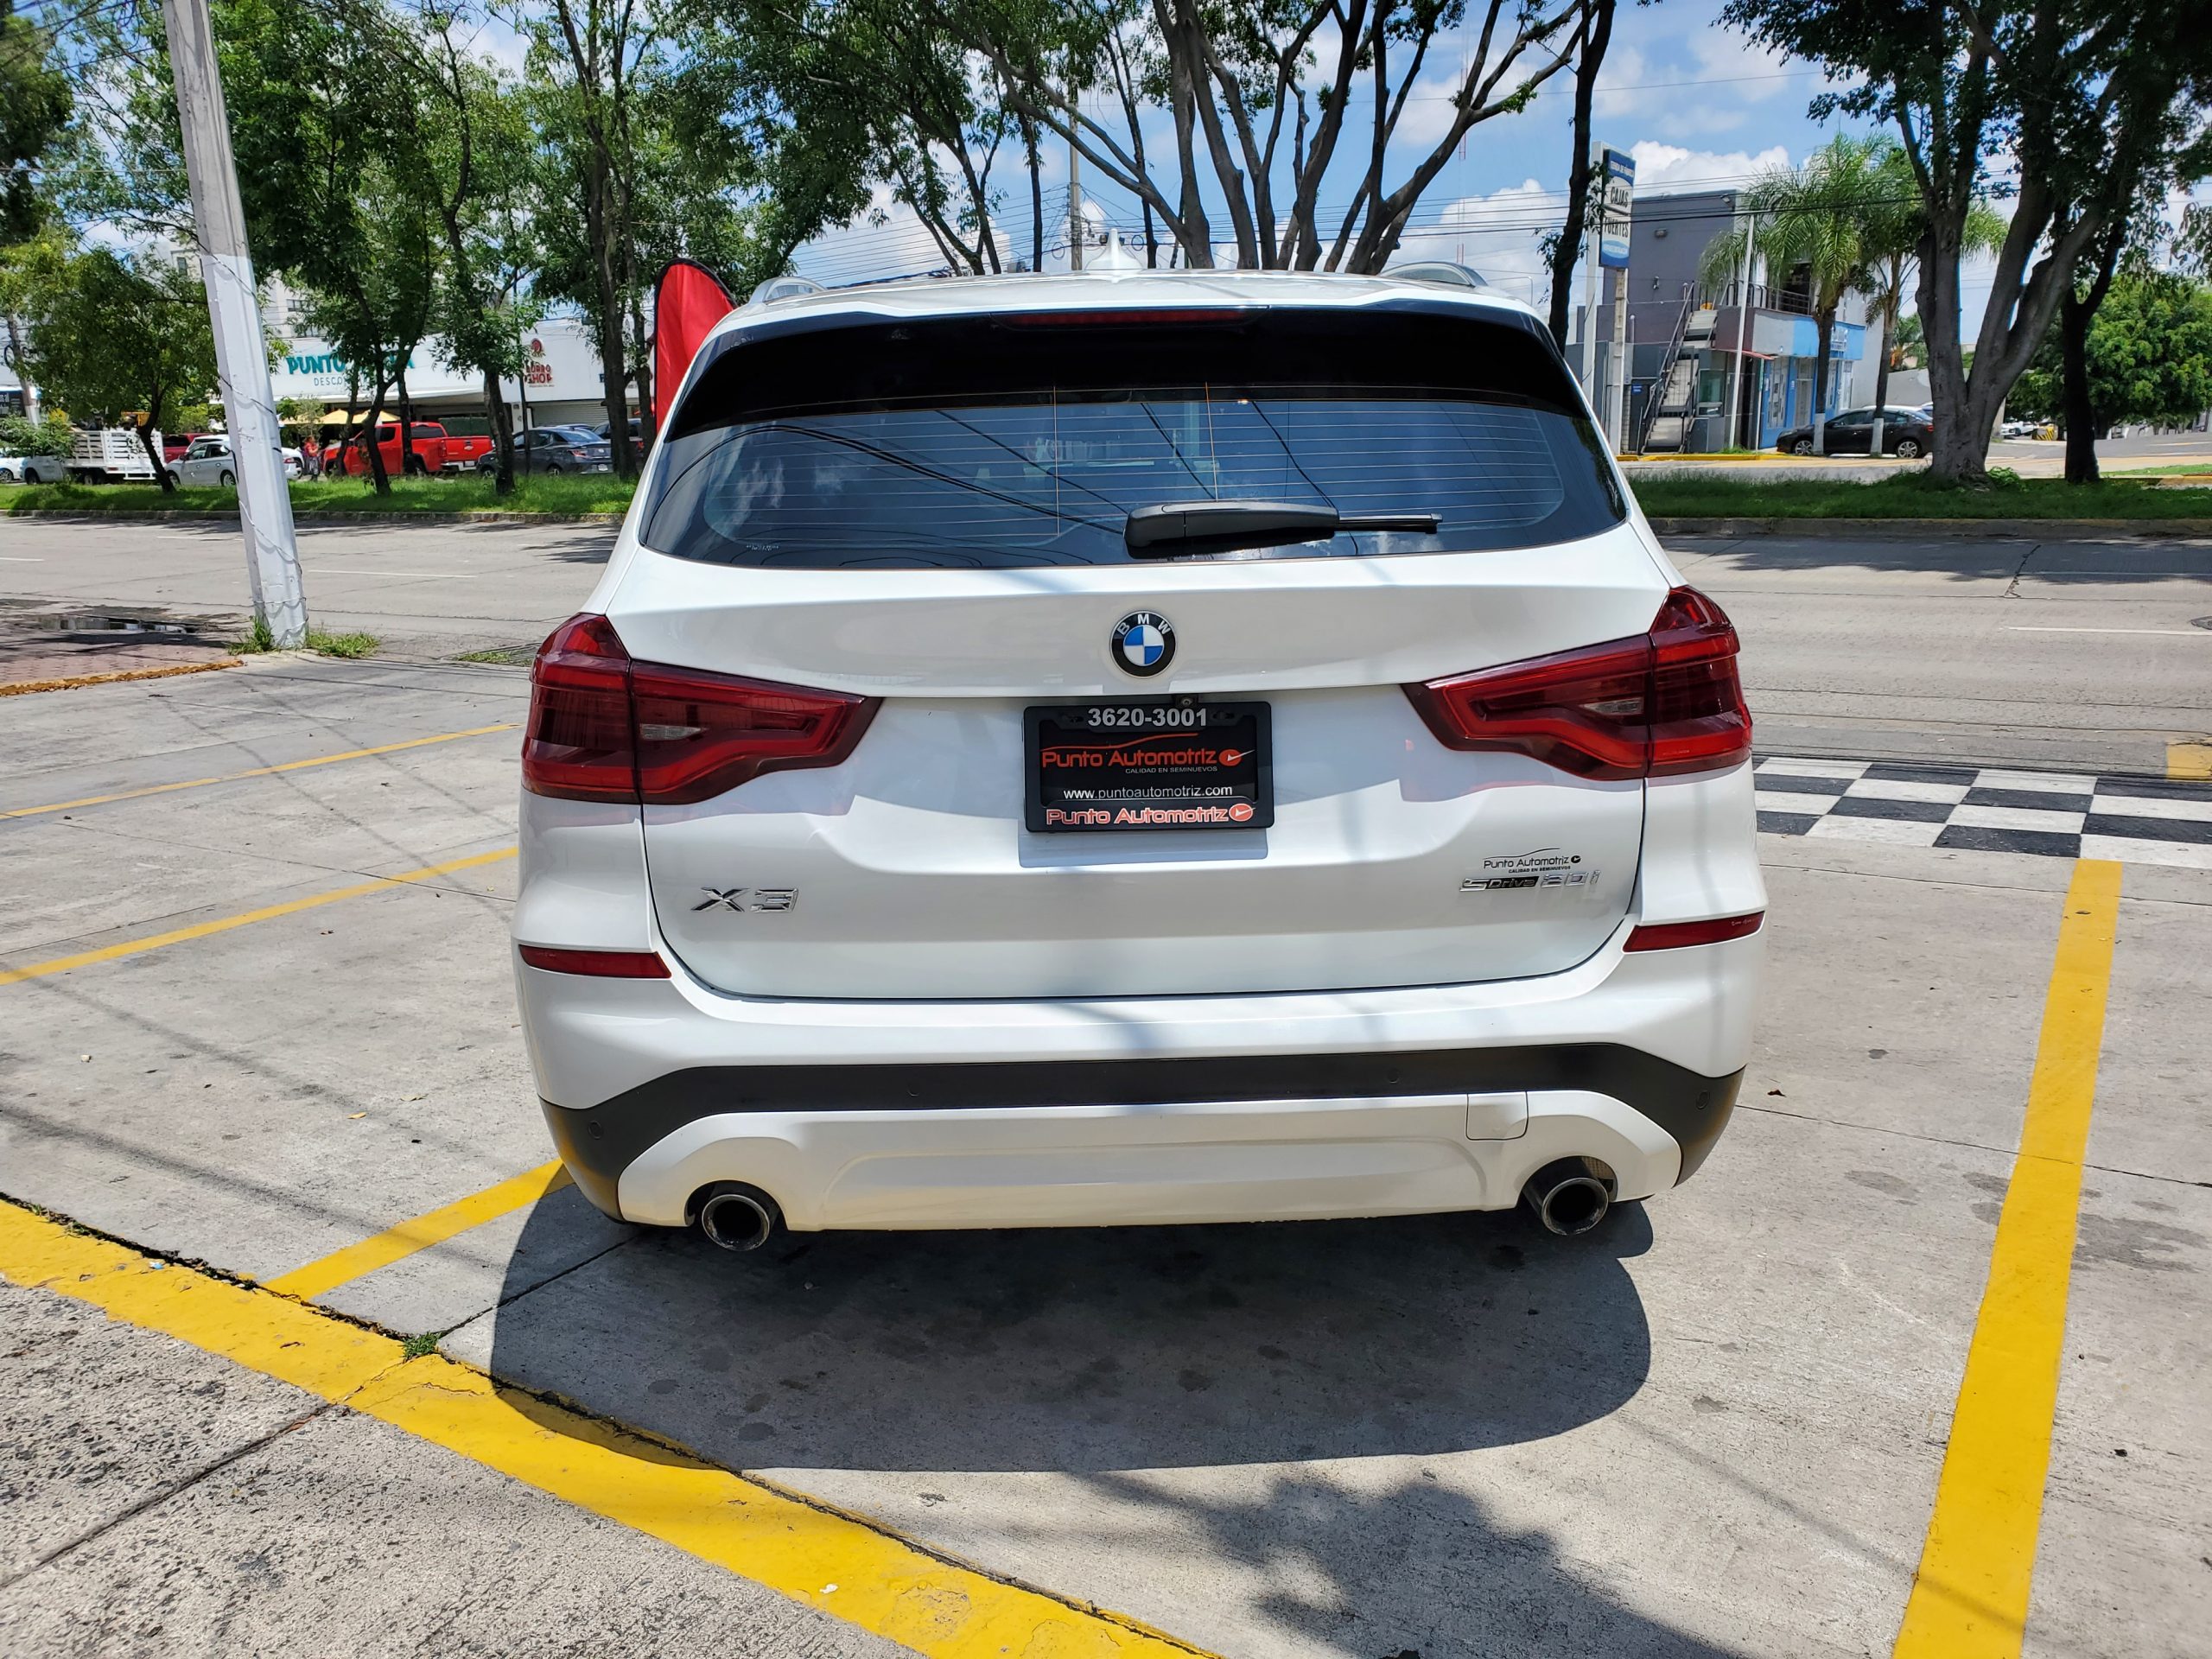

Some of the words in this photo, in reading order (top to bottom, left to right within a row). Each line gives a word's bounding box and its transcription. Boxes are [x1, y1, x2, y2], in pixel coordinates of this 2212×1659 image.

[1610, 186, 1630, 208] CAJAS
[1604, 216, 1630, 238] FUERTES
[286, 353, 346, 375] PUNTO
[1116, 613, 1172, 636] BMW
[1087, 708, 1207, 727] 3620-3001
[1042, 750, 1103, 768] Punto
[1108, 748, 1217, 767] Automotriz
[1063, 785, 1233, 800] www.puntoautomotriz.com
[1046, 809, 1111, 825] Punto
[1113, 805, 1229, 824] Automotriz
[1483, 860, 1514, 869] Punto
[1516, 855, 1570, 868] Automotriz
[690, 887, 799, 913] X3
